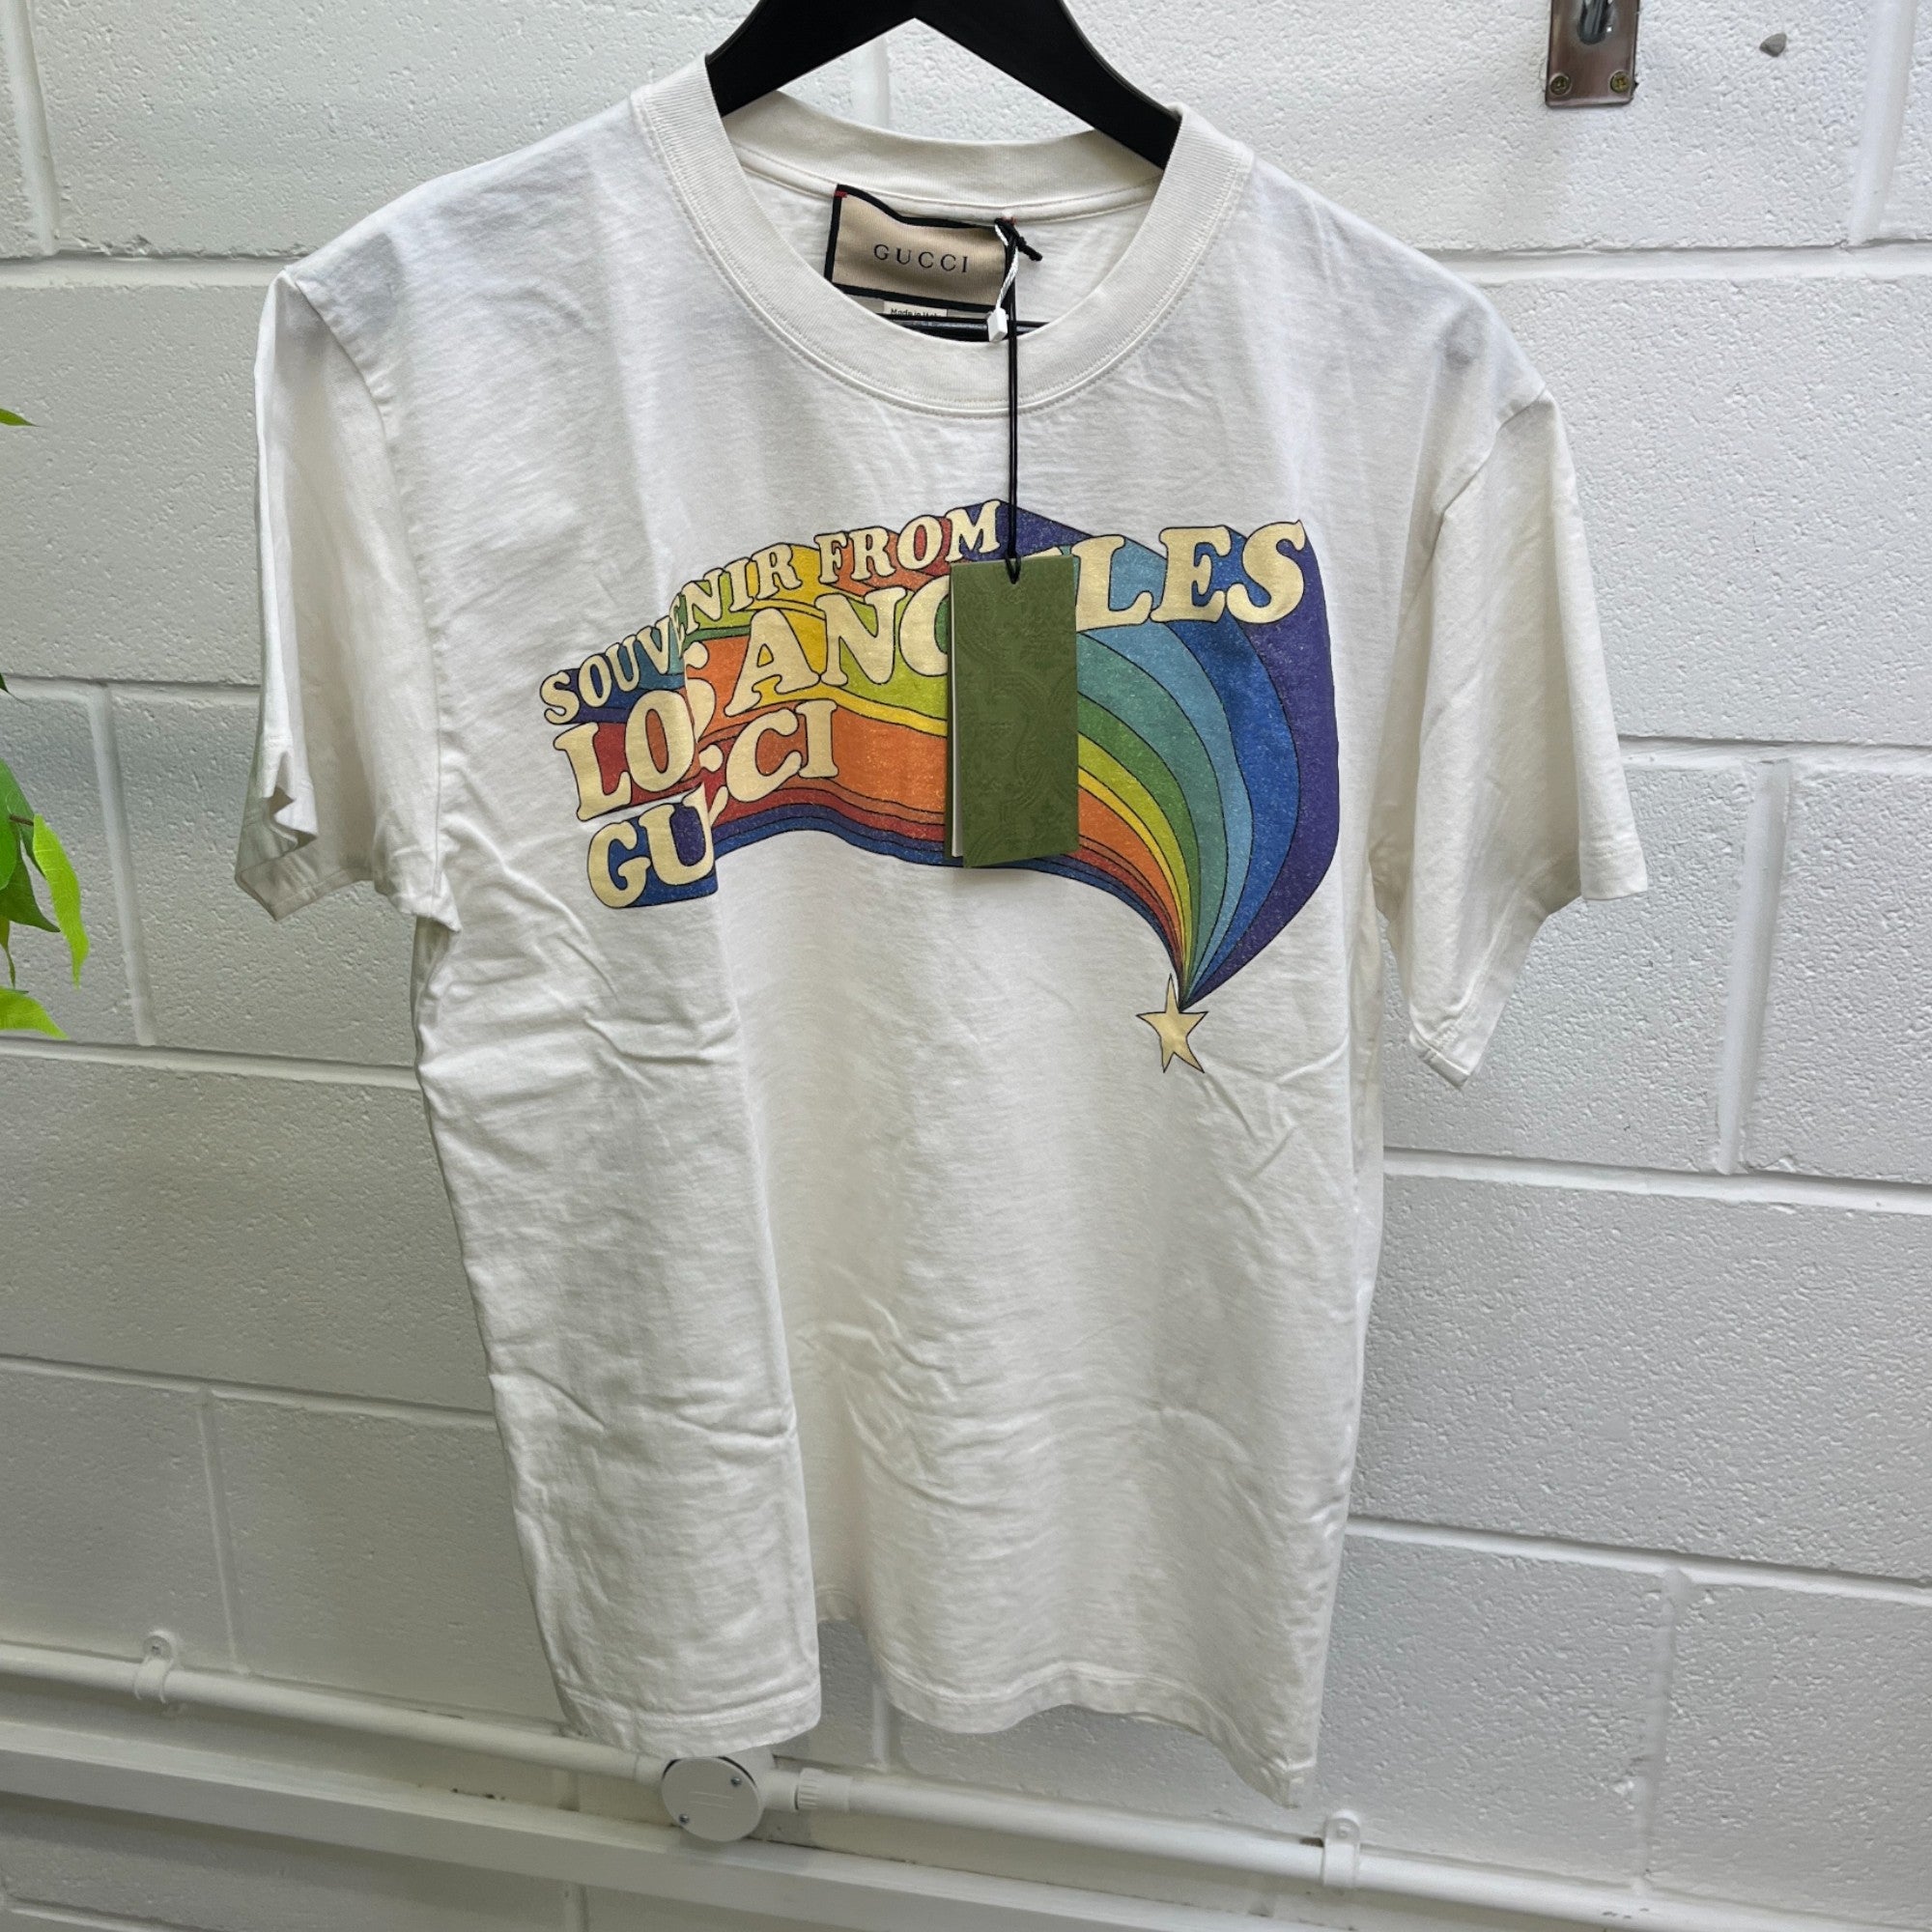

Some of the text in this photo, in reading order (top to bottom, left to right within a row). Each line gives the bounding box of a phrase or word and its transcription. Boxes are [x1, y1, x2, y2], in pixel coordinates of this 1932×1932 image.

[873, 243, 969, 273] GUCCI
[540, 499, 1001, 724] SOUVENIR FROM
[724, 519, 1307, 717] ANLES
[586, 699, 838, 909] GUCI
